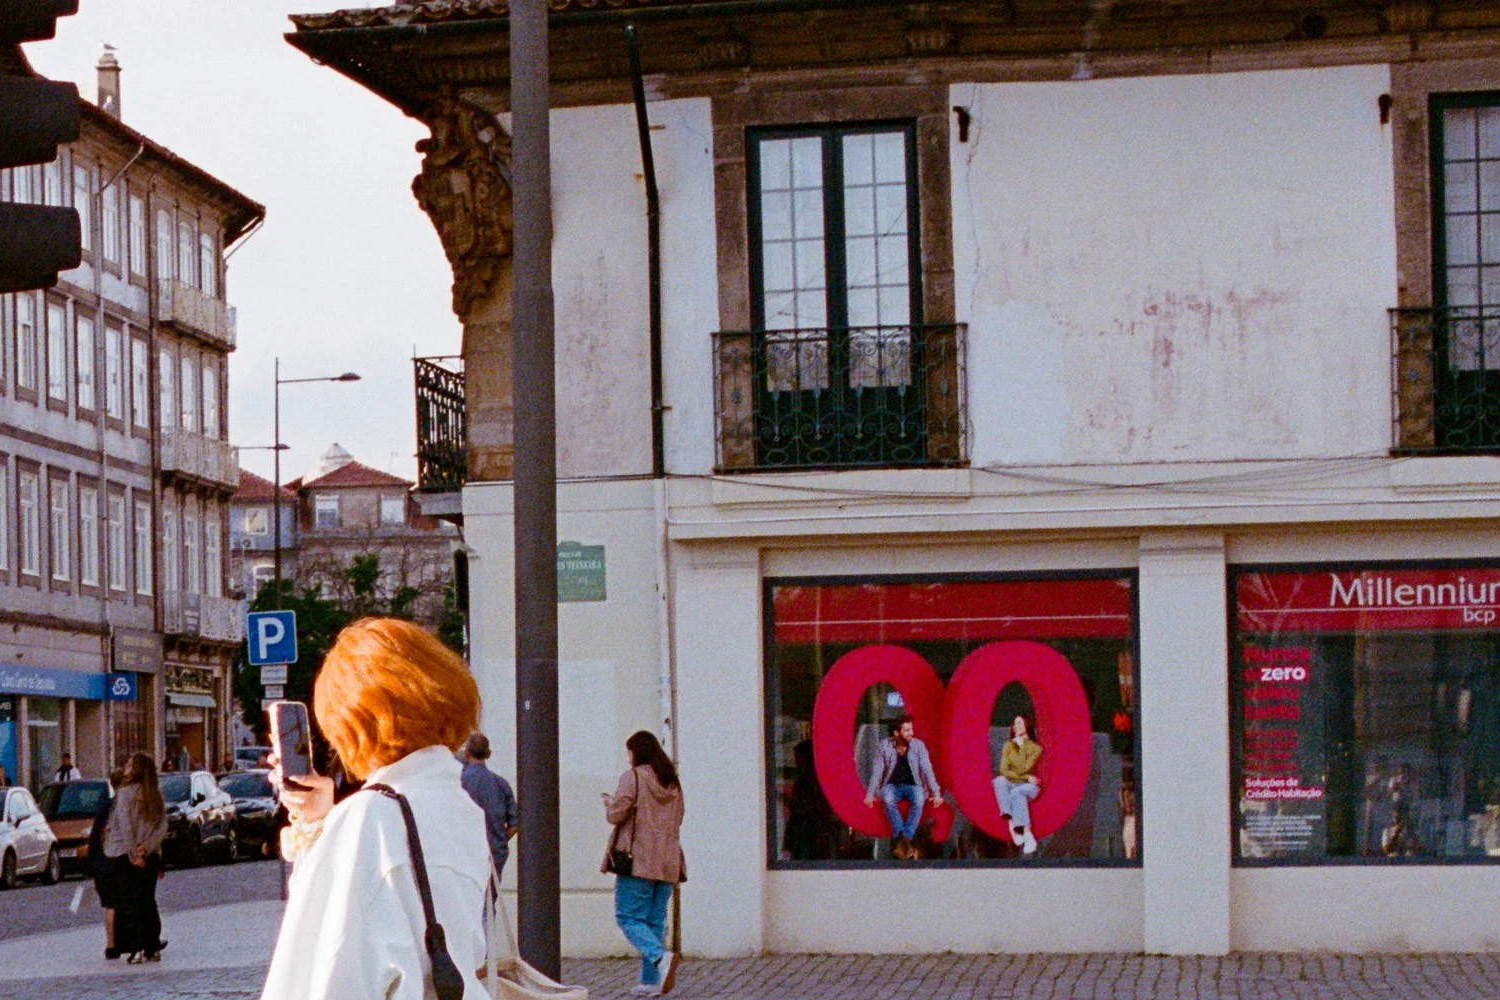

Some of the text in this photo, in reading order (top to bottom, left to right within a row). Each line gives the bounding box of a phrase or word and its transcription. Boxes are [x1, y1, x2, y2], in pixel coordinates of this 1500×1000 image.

[1463, 607, 1496, 624] bcp
[257, 617, 285, 660] P
[1260, 666, 1306, 682] zero
[1244, 683, 1300, 700] valeu
[1245, 777, 1299, 789] Soluções de
[1277, 787, 1323, 799] Habitação
